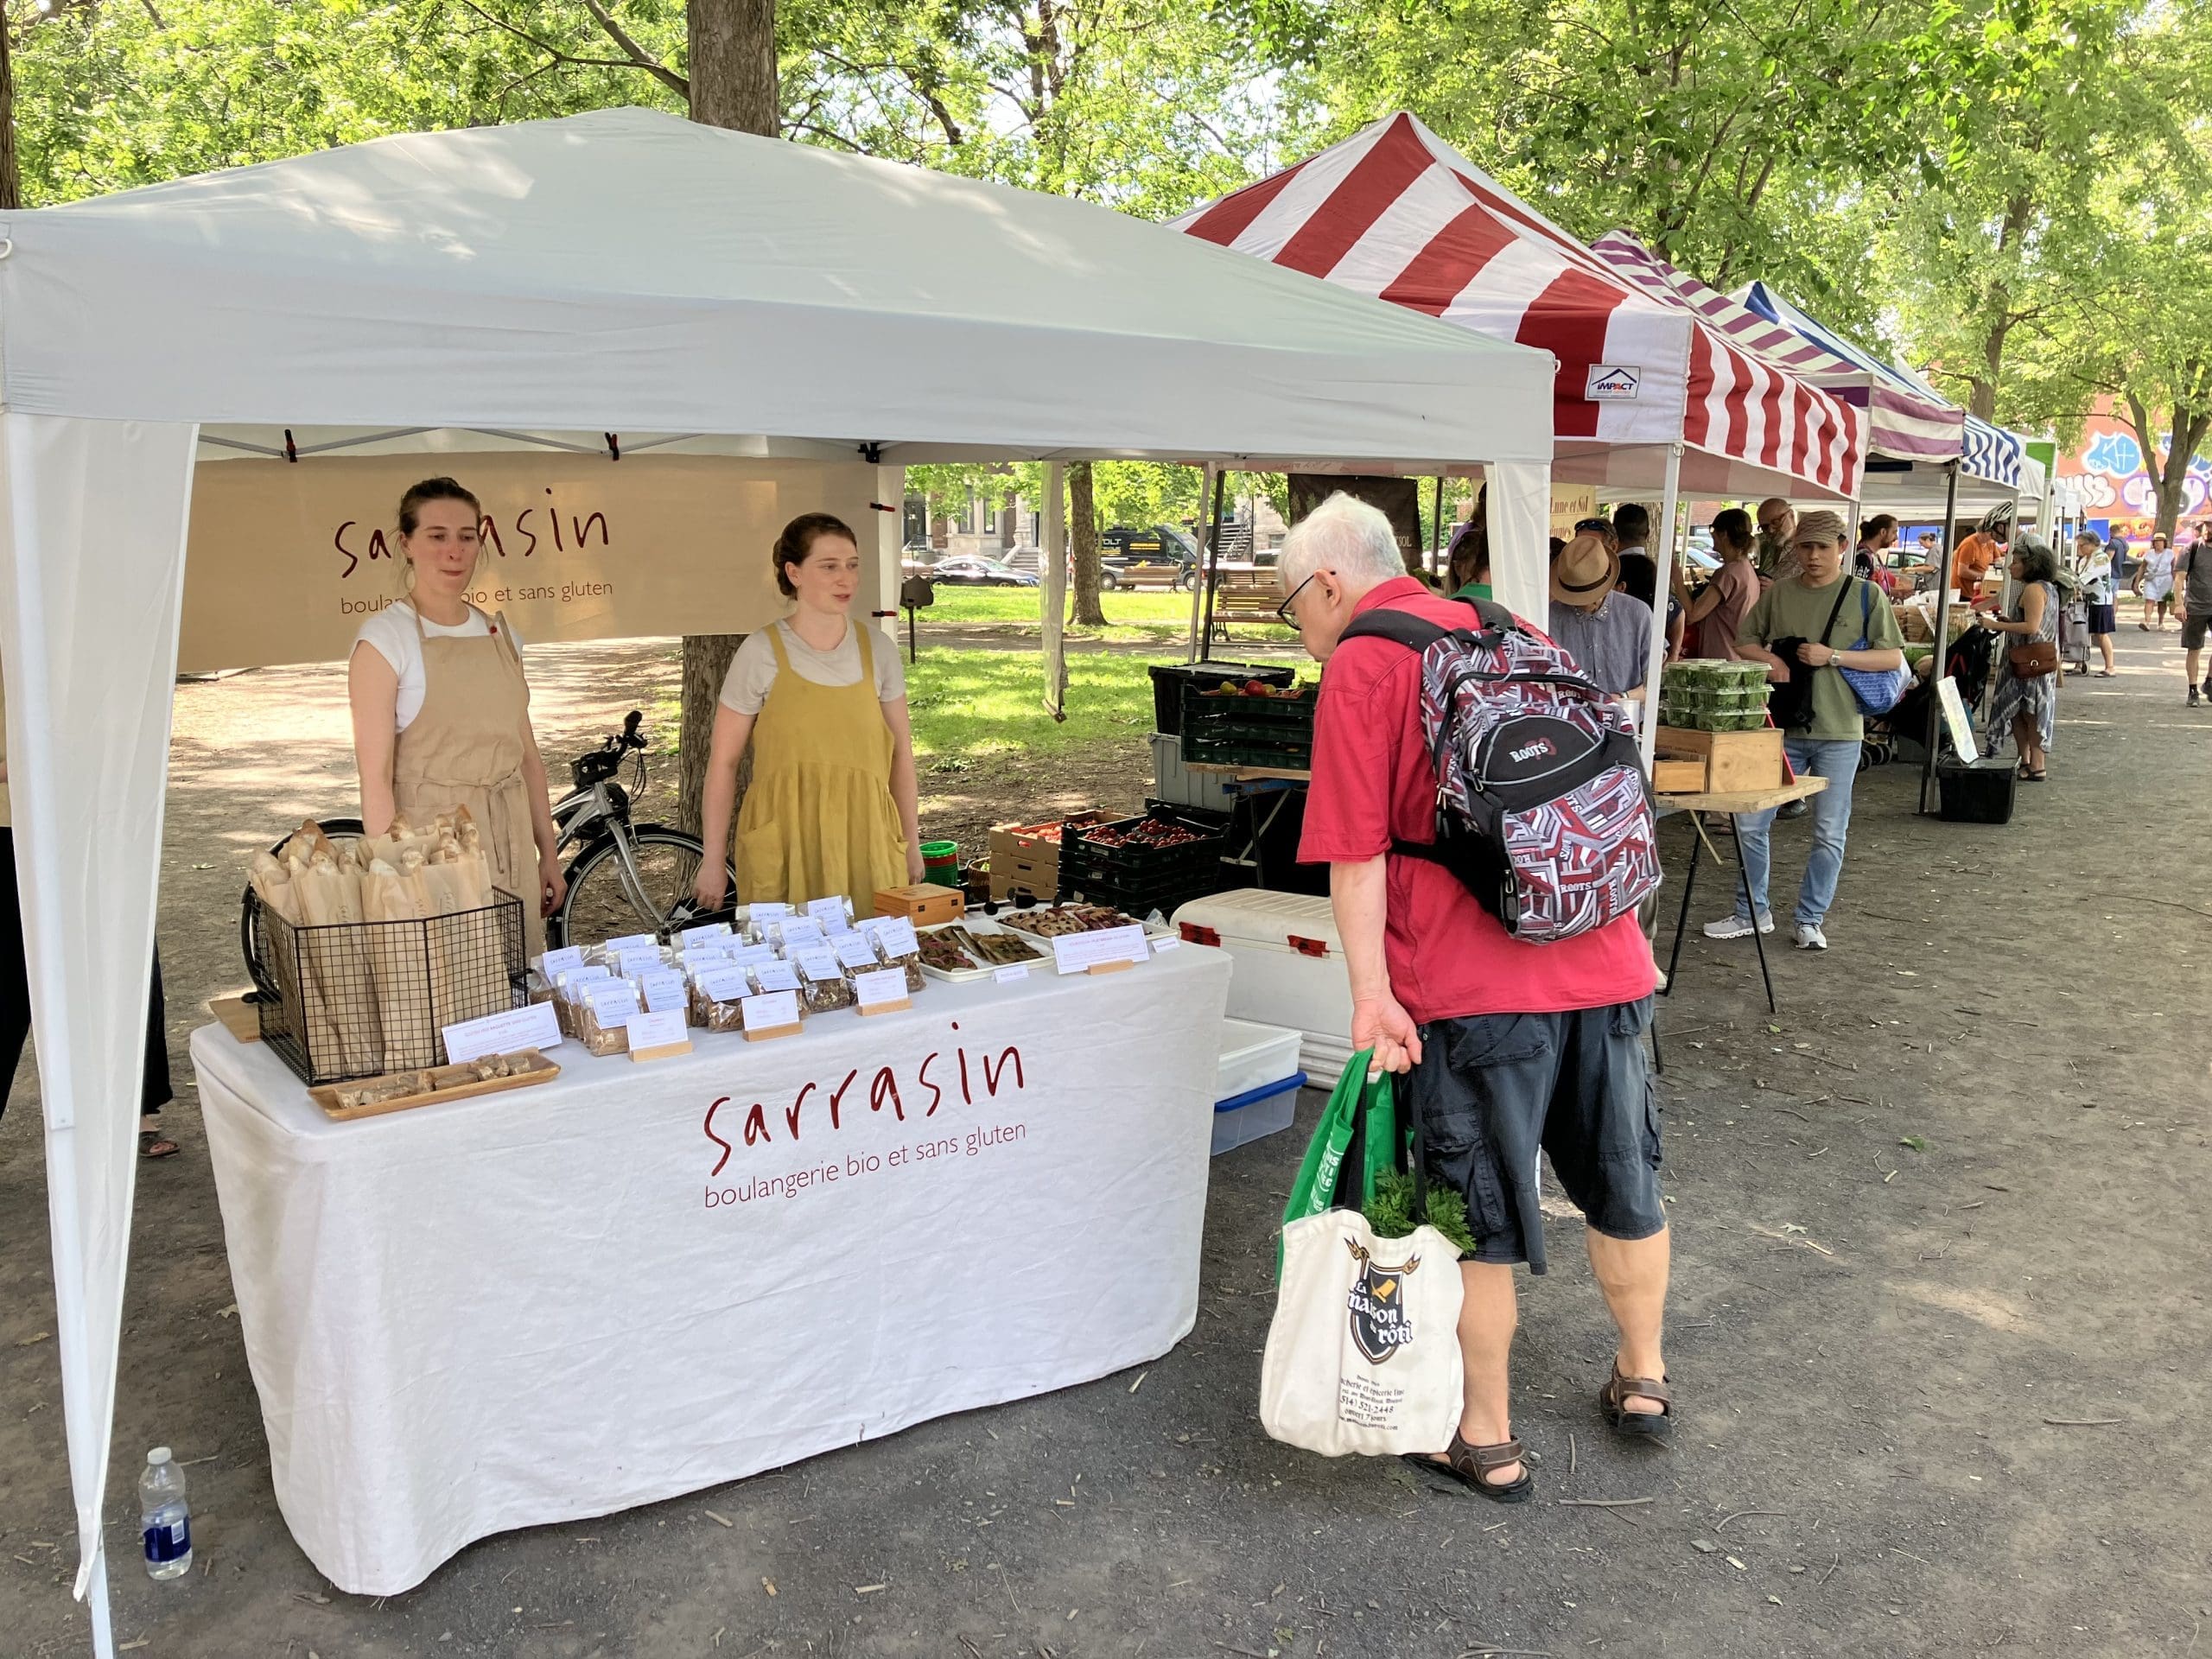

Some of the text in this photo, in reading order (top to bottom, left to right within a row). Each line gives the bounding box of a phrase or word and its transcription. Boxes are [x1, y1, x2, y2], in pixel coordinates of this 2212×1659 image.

[334, 487, 609, 578] saasin
[494, 587, 512, 601] et
[518, 586, 555, 601] sans
[562, 581, 613, 602] gluten
[1509, 742, 1549, 763] ROOTS
[1560, 881, 1592, 893] ROOTS
[704, 1021, 1024, 1177] sarrasin
[705, 1123, 1027, 1209] boulangerie bio et sans gluten
